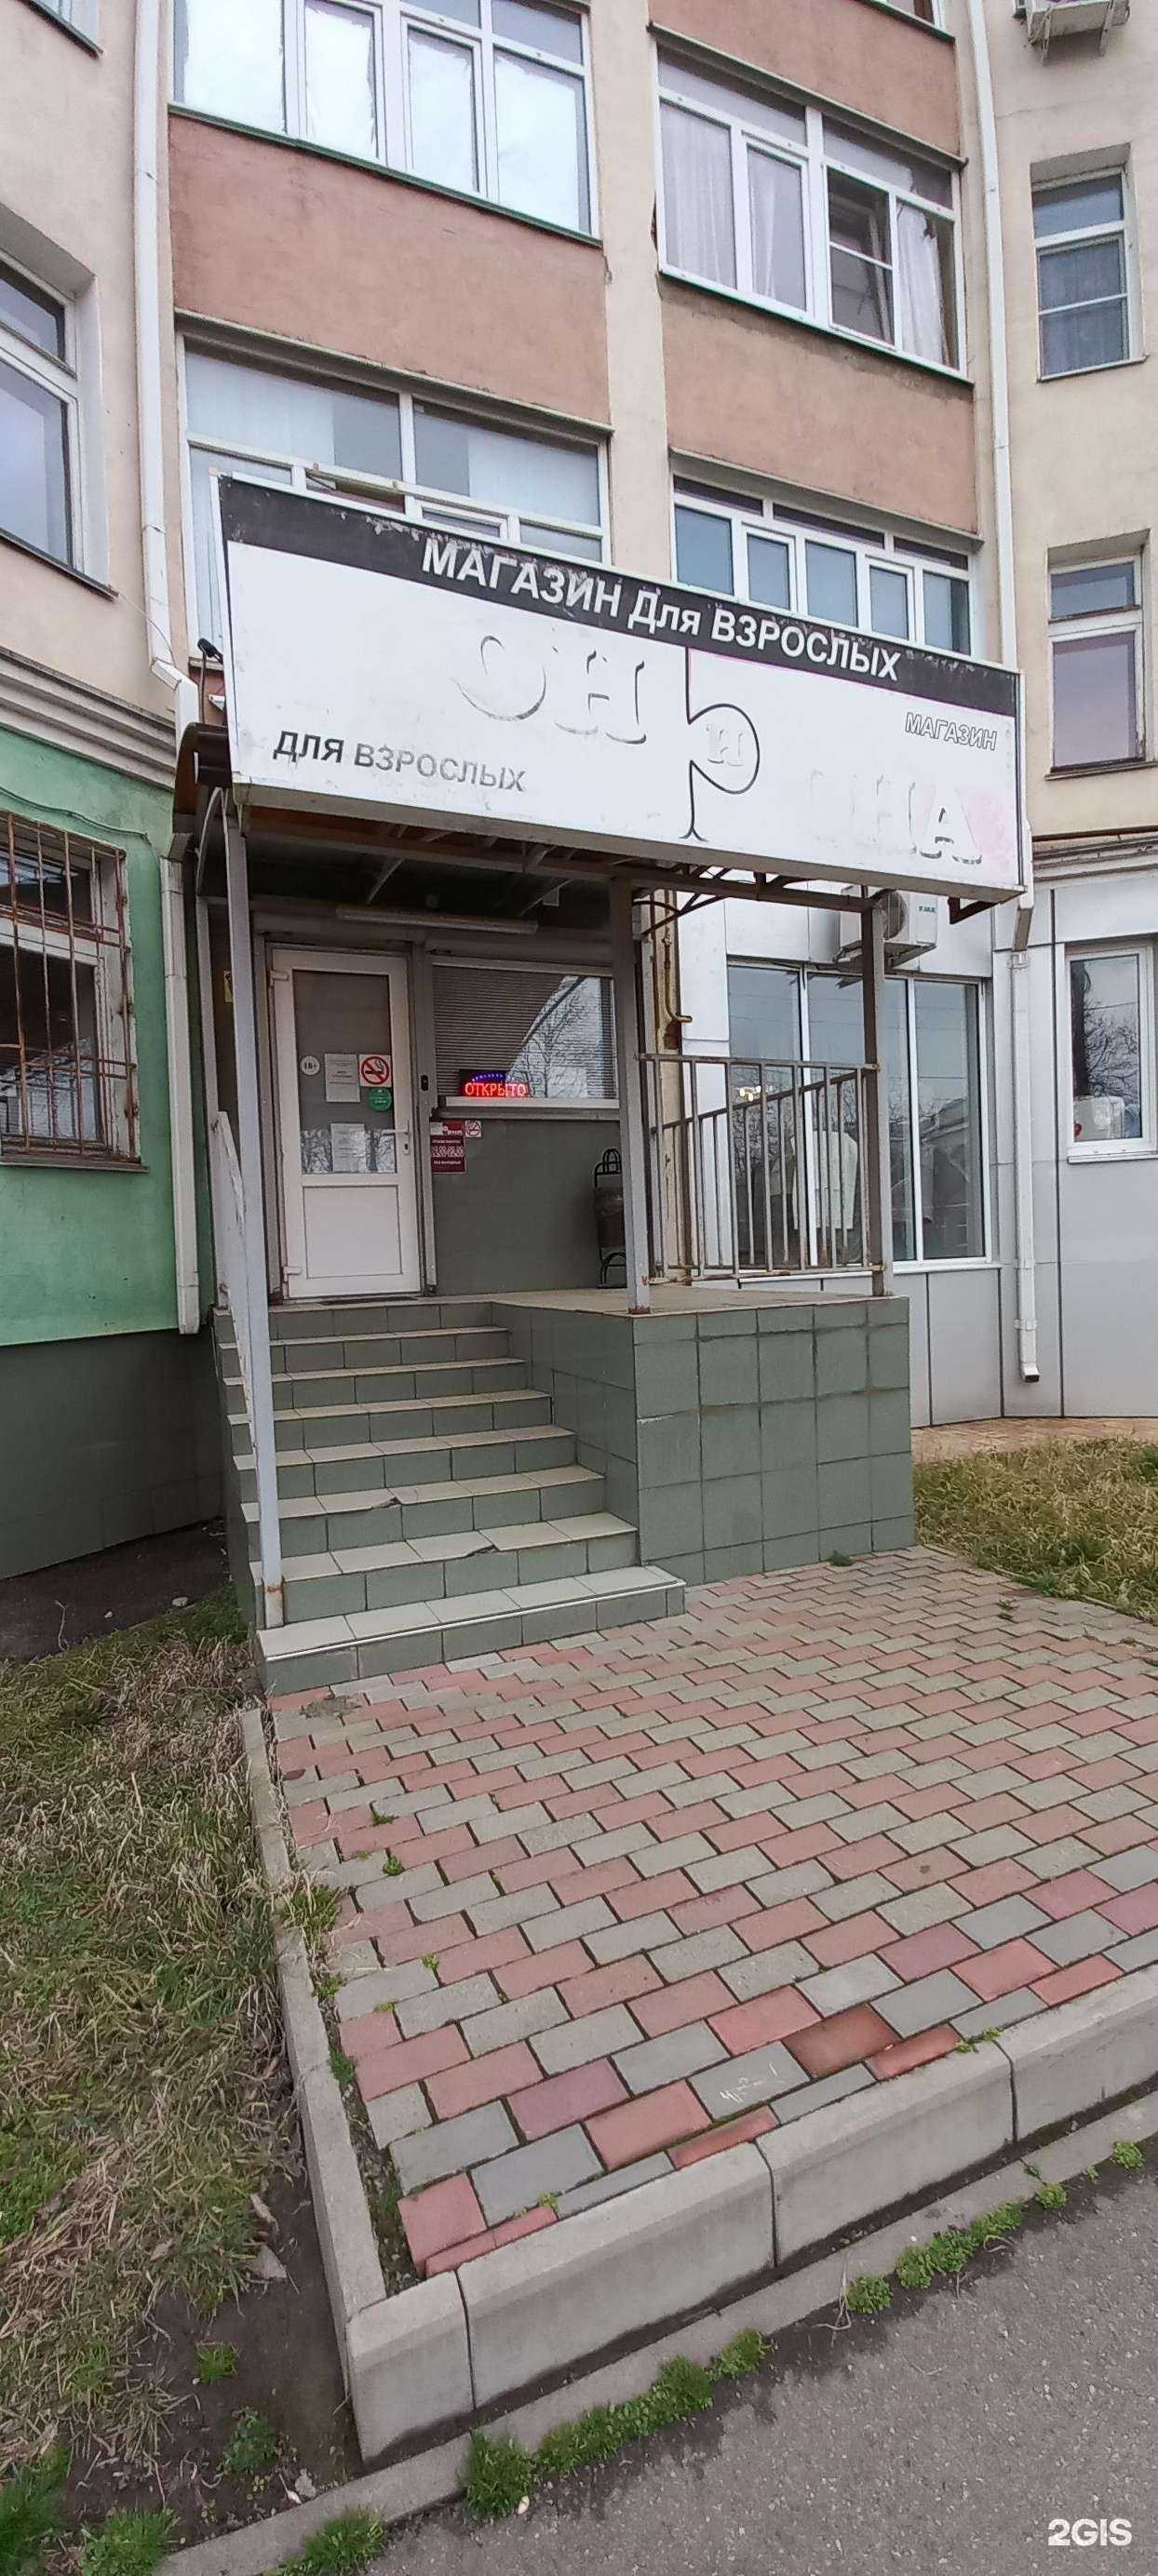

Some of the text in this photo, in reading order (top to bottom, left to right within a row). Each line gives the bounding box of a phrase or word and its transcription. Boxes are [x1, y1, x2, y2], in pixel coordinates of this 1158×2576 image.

[422, 537, 901, 681] МАГАЗИН Для ВЗРОСЛЫХ
[905, 711, 998, 751] МАГАЗИН
[272, 731, 527, 792] ДЛЯ ВЗРОСЛЫХ
[465, 1082, 527, 1096] ОТКРЫТО
